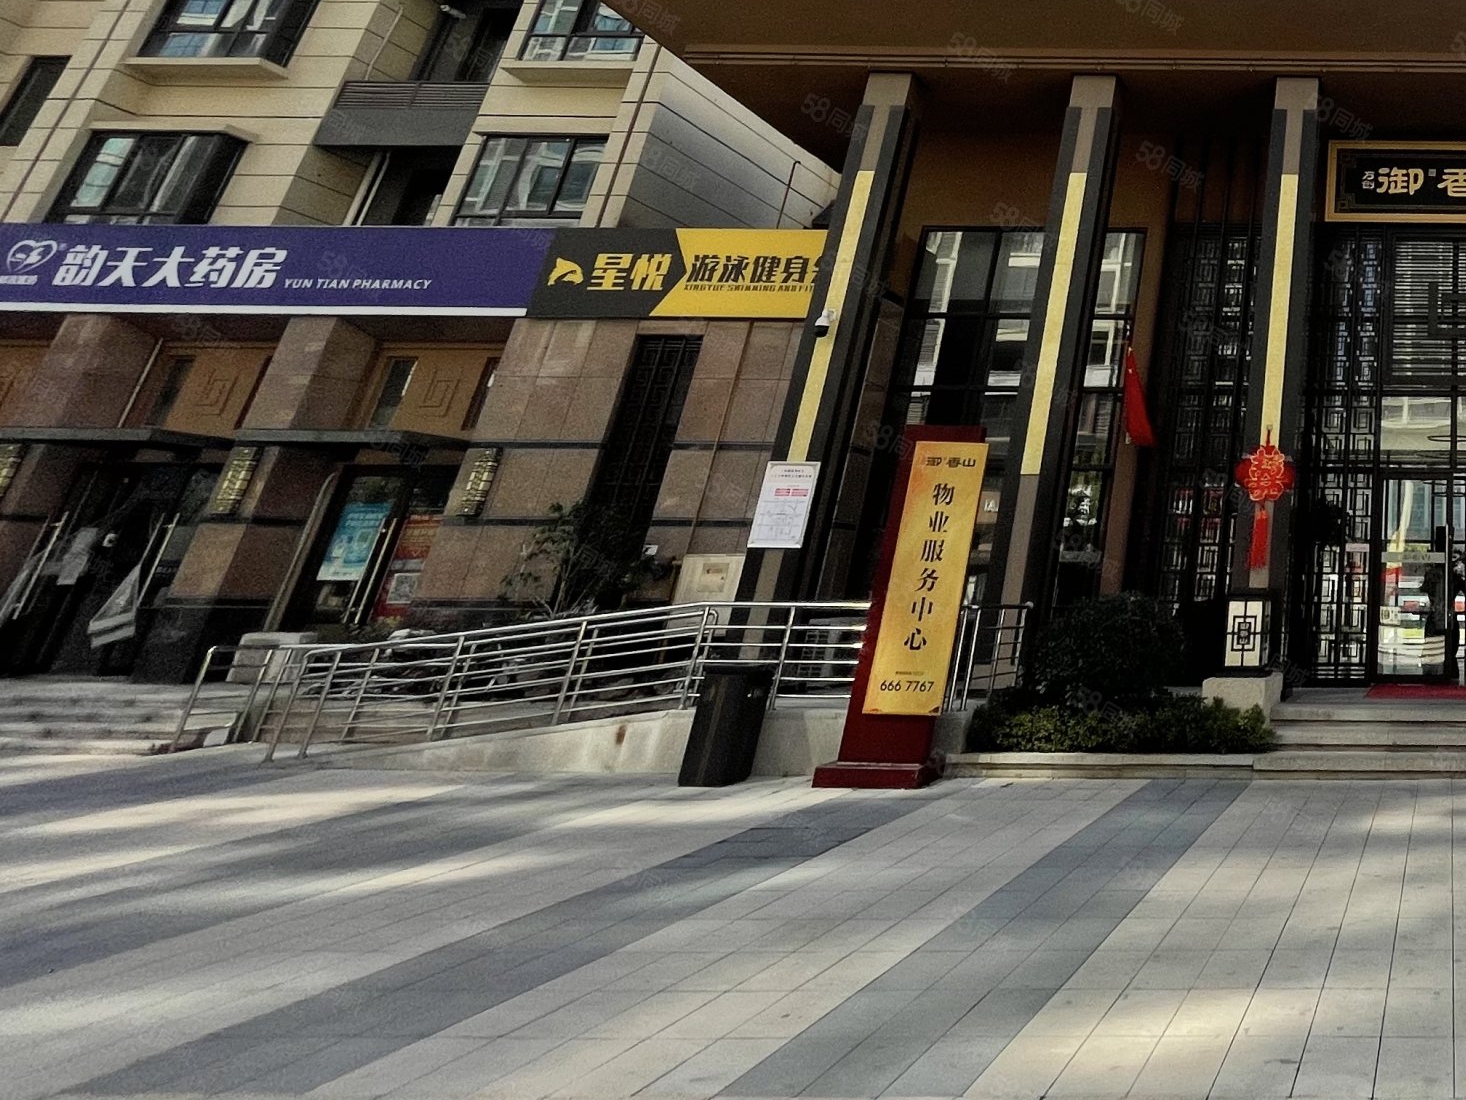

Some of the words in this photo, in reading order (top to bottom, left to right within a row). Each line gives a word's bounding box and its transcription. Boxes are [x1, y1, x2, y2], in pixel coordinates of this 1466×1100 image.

[53, 244, 288, 289] 韵天大药房
[284, 278, 313, 289] YUN
[316, 278, 349, 289] TIAN
[351, 279, 432, 289] PHARMACY
[587, 253, 673, 291] 星悦
[904, 483, 955, 651] 物业服务中心
[880, 680, 901, 692] 666
[905, 680, 934, 692] 7767
